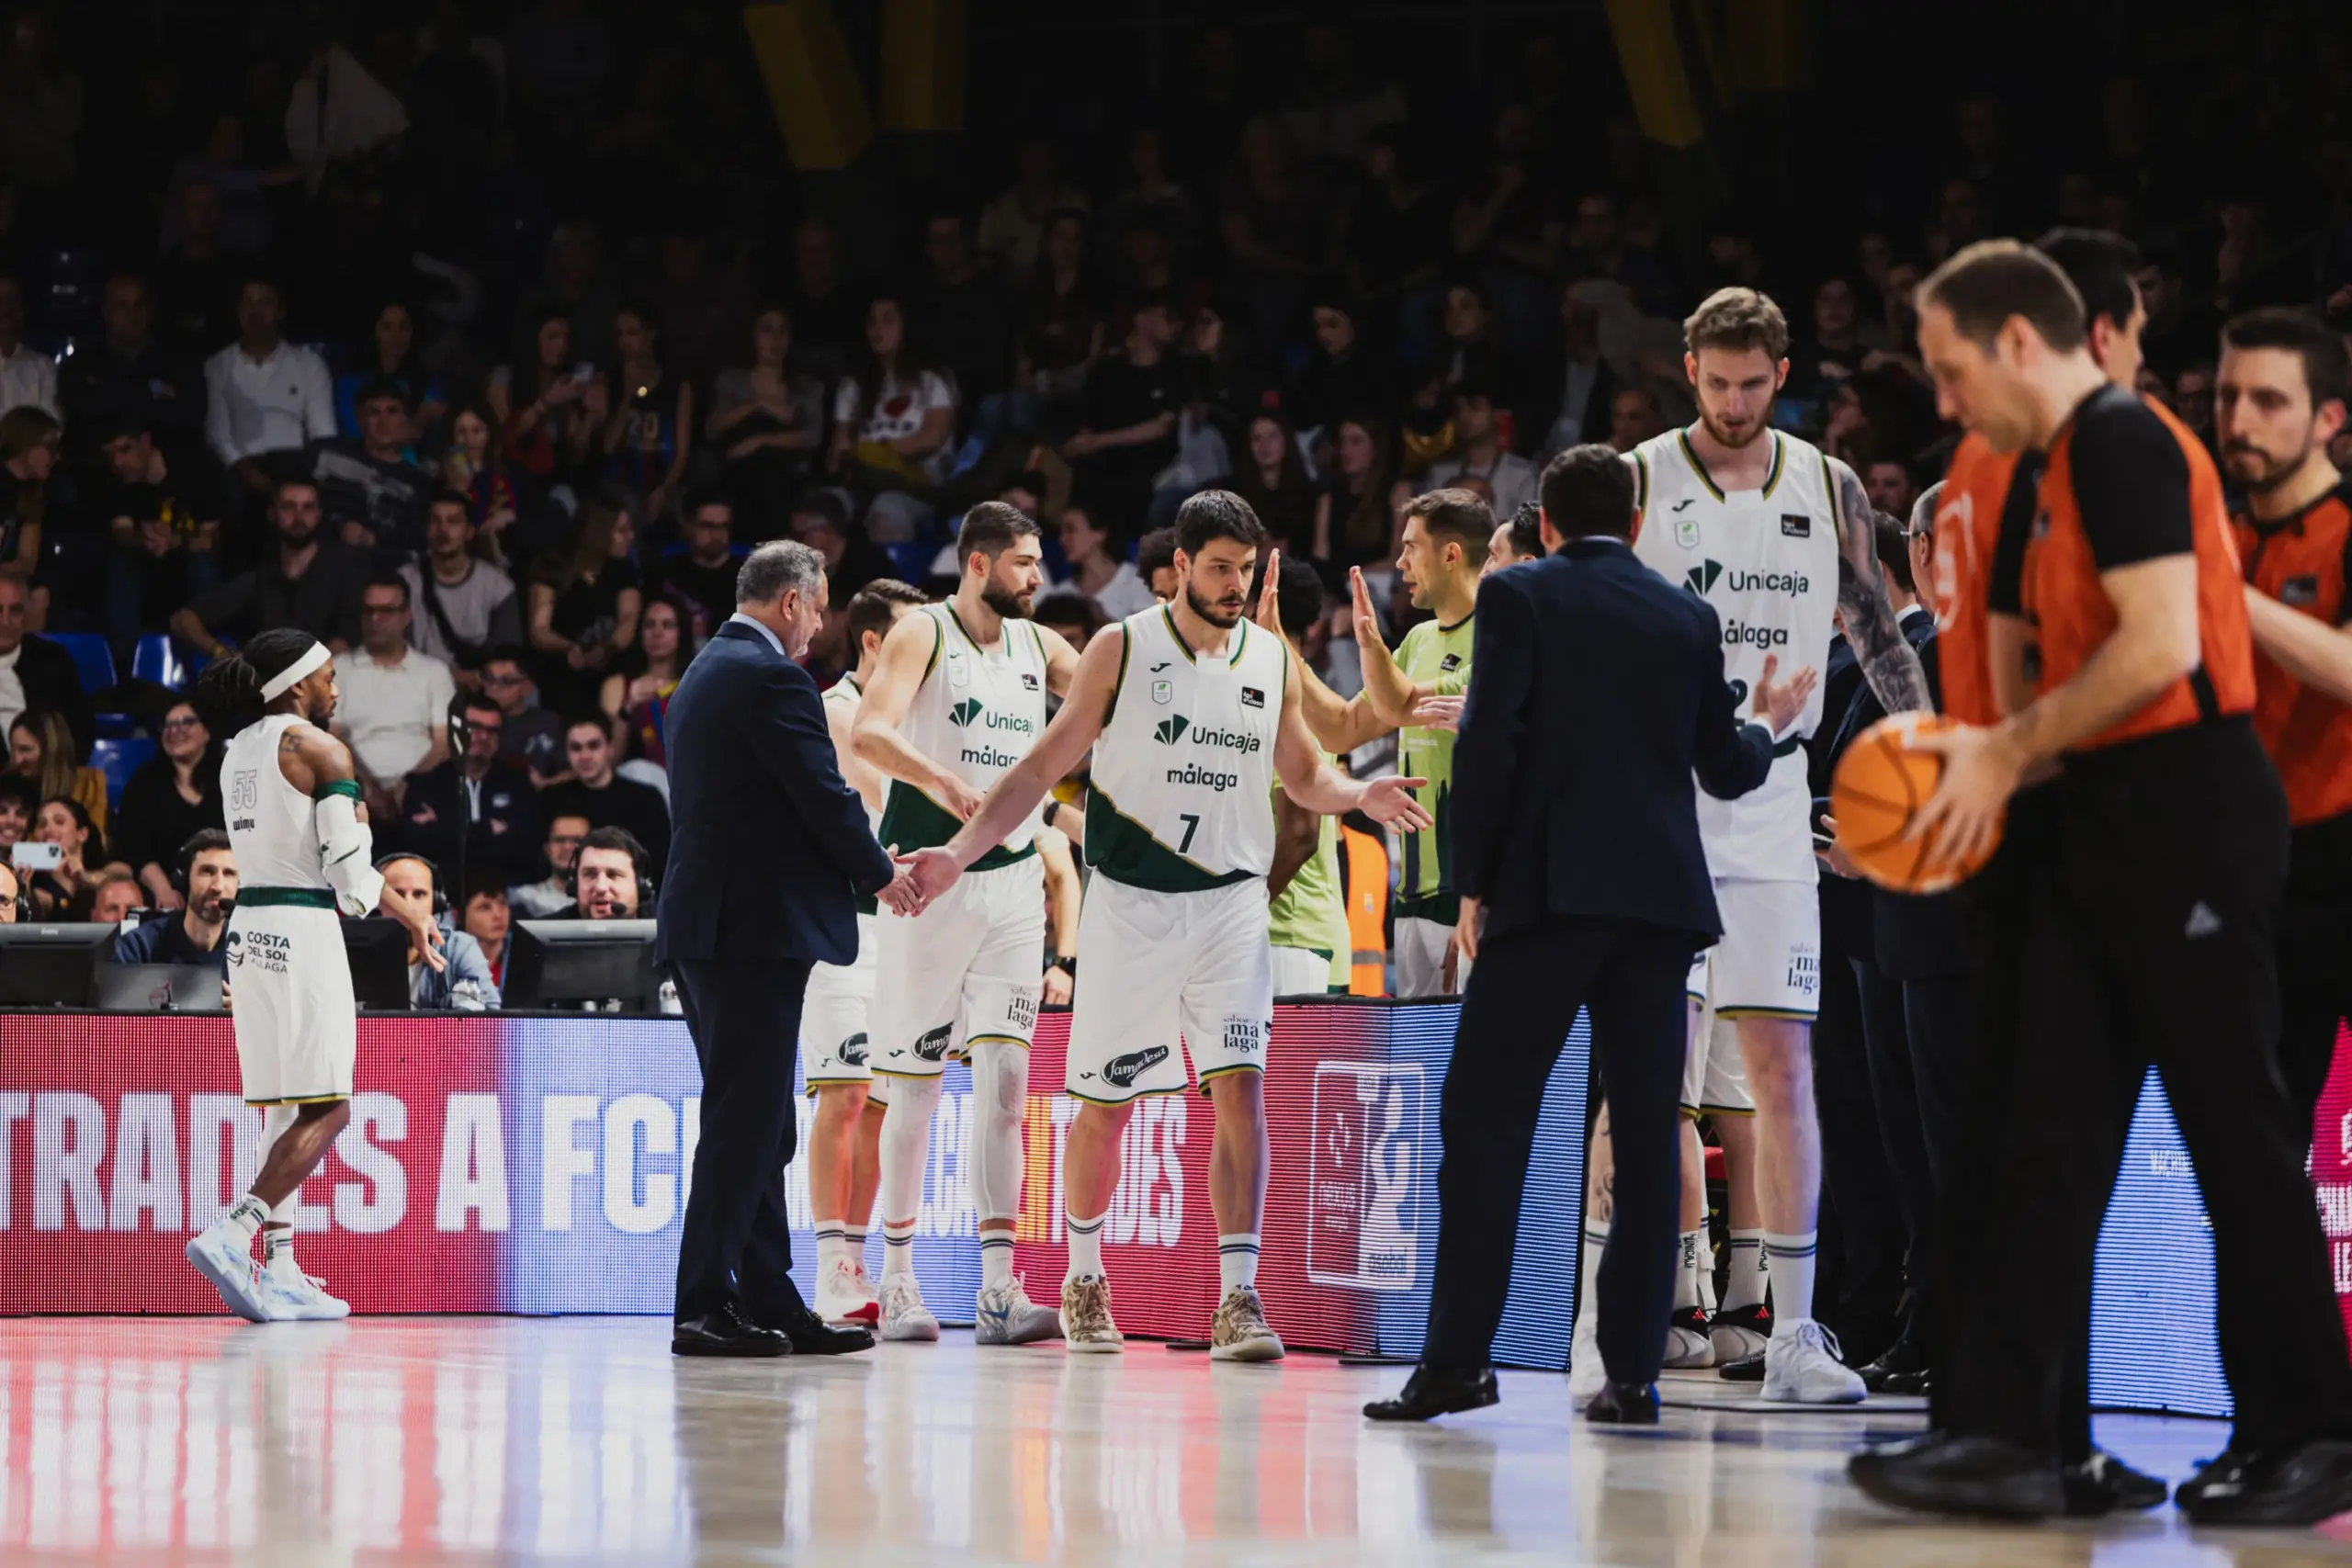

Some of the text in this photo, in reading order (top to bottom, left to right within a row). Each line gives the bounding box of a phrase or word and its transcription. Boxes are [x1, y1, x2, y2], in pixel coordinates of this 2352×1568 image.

[1729, 570, 1809, 598] Unicaja
[1192, 727, 1261, 754] Unicaja
[231, 769, 257, 811] 55
[1178, 813, 1200, 853] 7
[247, 931, 290, 949] COSTA
[266, 948, 289, 962] SOL
[1224, 1032, 1259, 1053] laga
[0, 1091, 407, 1233] RADS
[435, 1093, 511, 1233] A
[543, 1093, 701, 1233] FC
